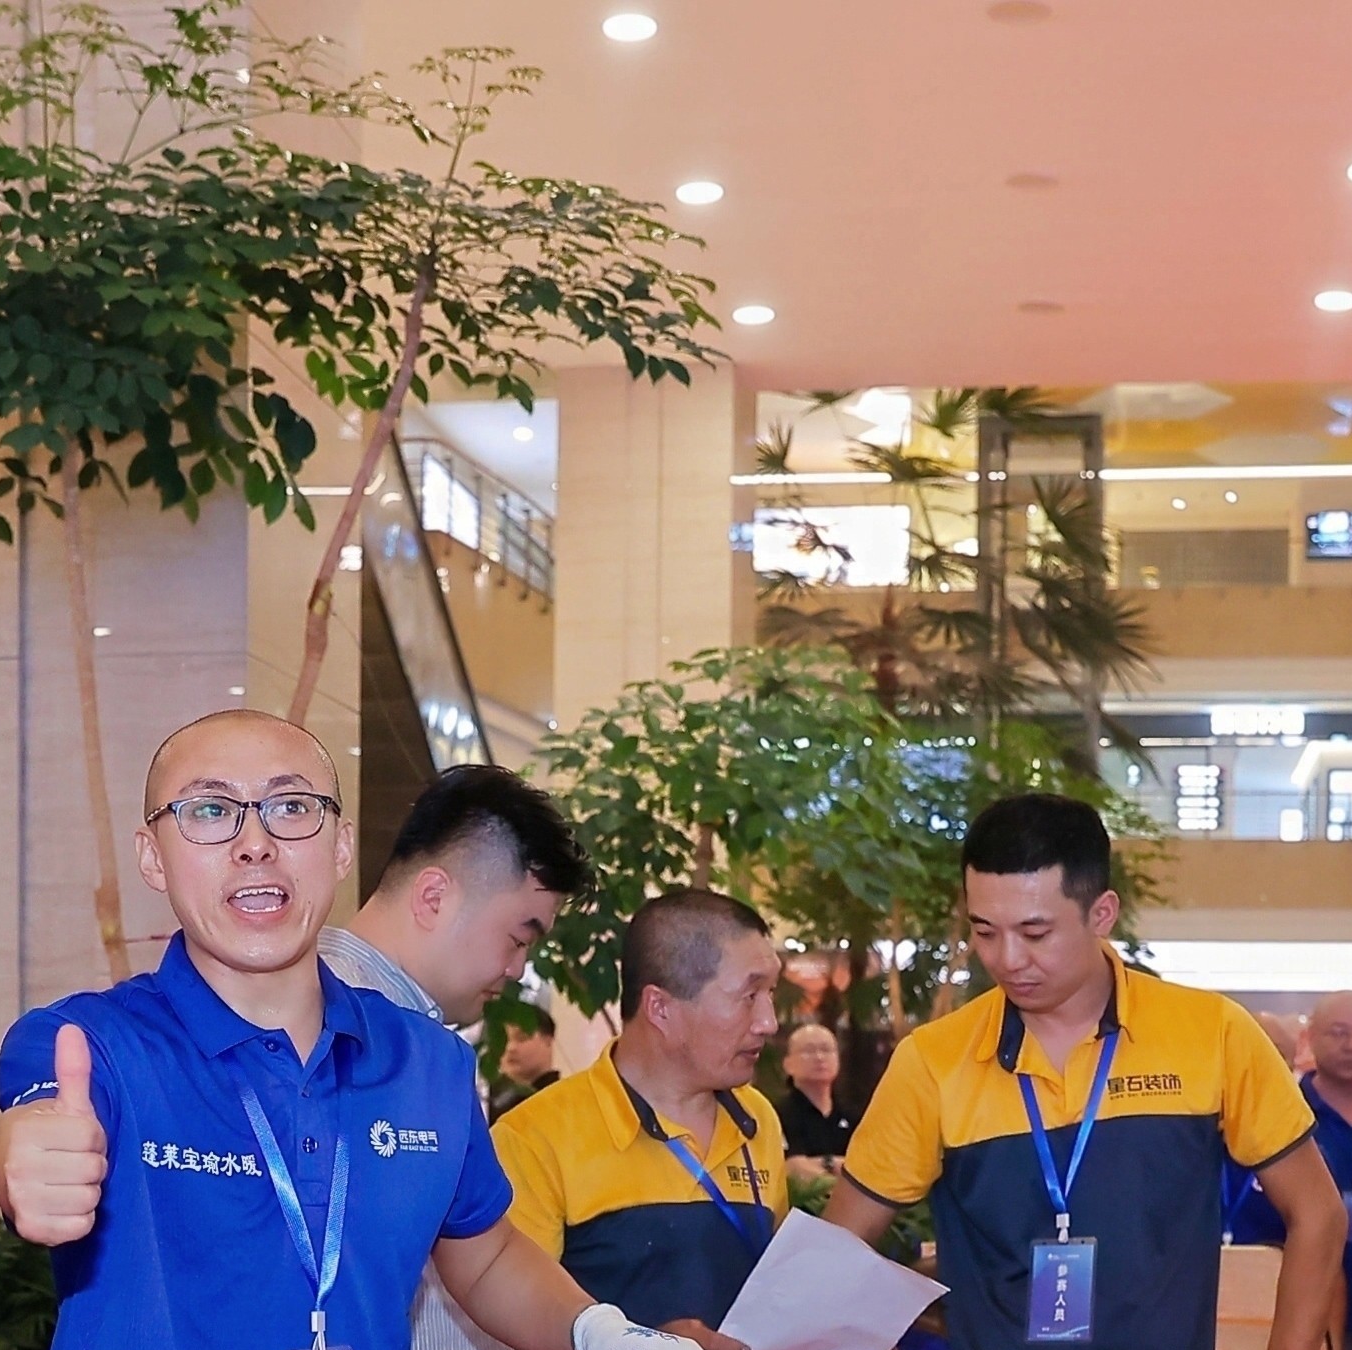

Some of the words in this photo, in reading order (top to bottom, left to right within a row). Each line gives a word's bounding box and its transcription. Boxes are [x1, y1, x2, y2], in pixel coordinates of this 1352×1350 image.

[397, 1129, 439, 1146] 远东电气
[142, 1140, 263, 1177] 蓬莱宝瑜水暖
